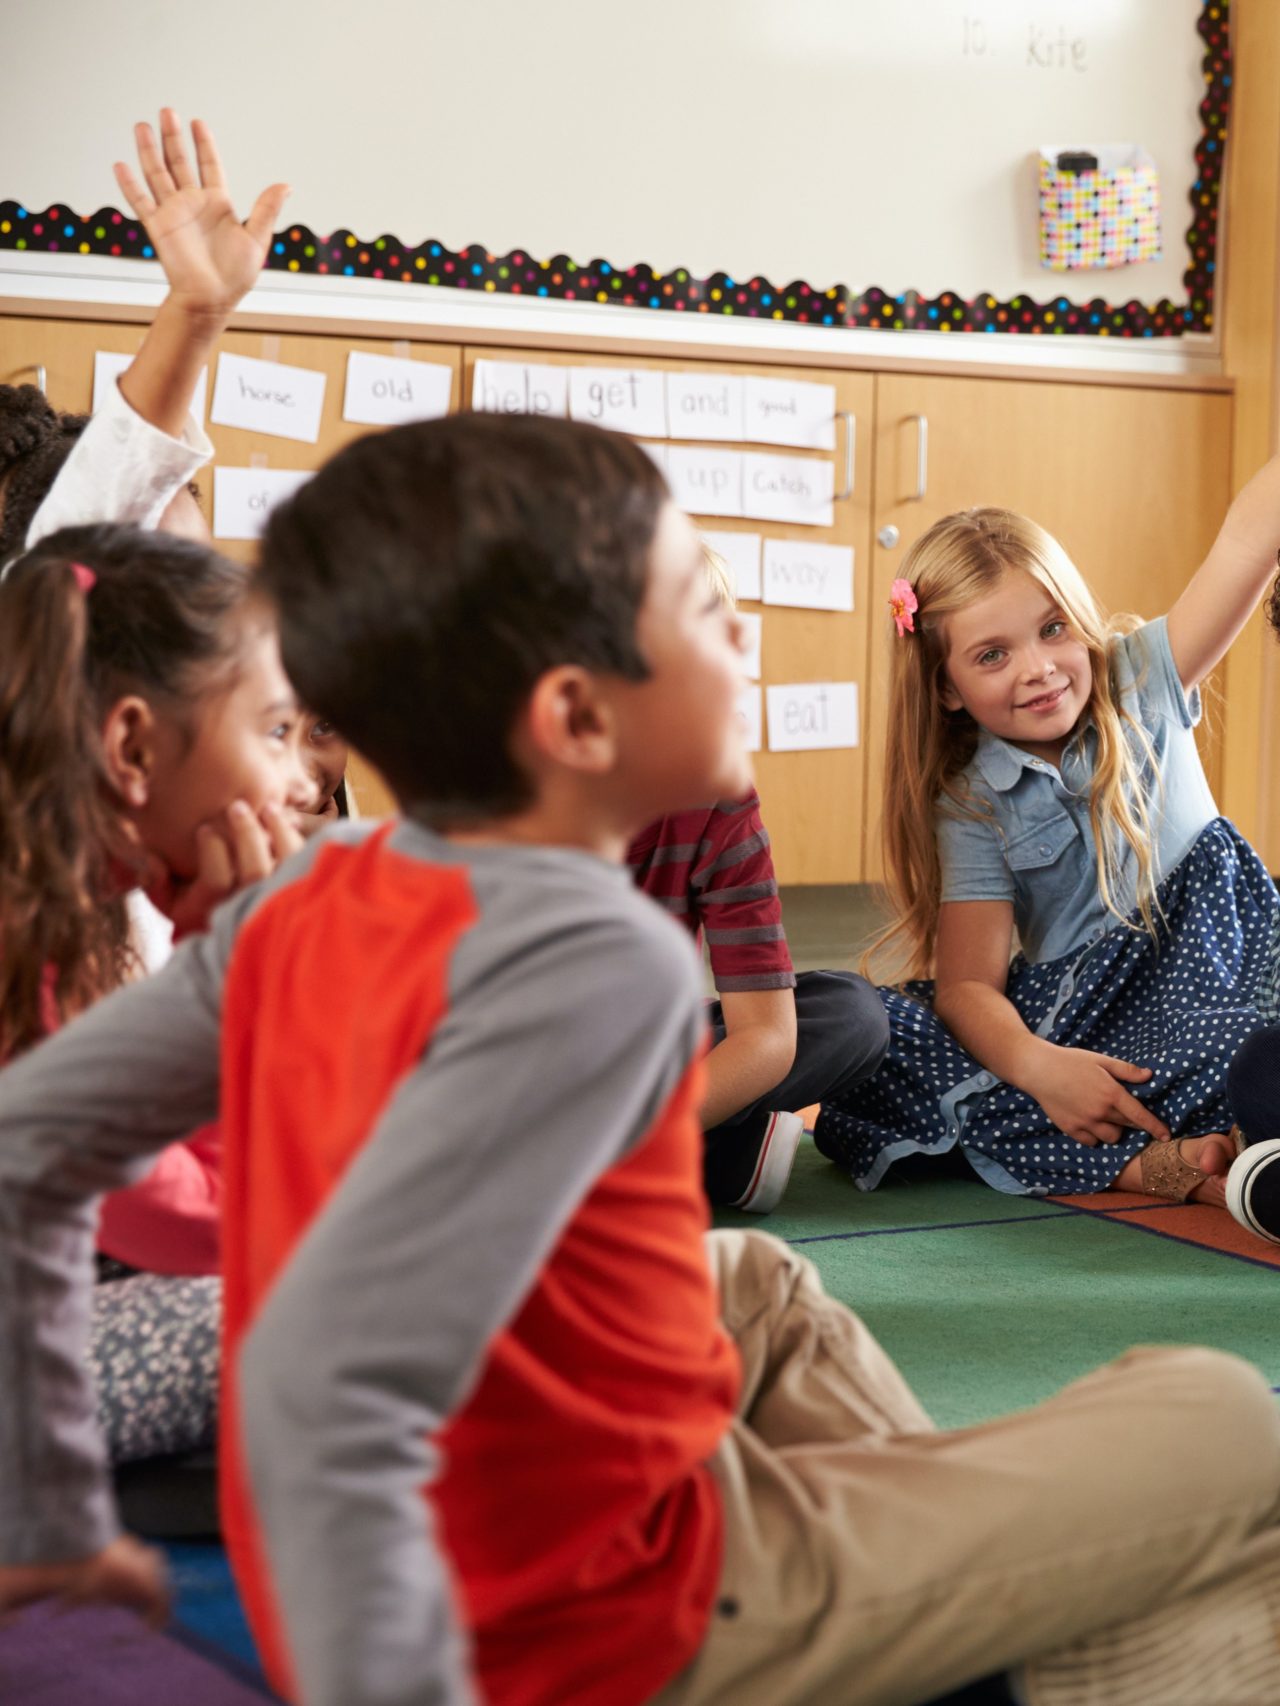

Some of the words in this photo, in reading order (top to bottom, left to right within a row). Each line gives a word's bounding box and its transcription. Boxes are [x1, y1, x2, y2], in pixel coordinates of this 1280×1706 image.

[237, 374, 297, 408] horse
[371, 378, 414, 402] old
[482, 367, 552, 414] help
[588, 372, 641, 418] get
[680, 385, 730, 417] and
[687, 466, 729, 496] up
[770, 559, 831, 596] way
[783, 688, 831, 735] eat
